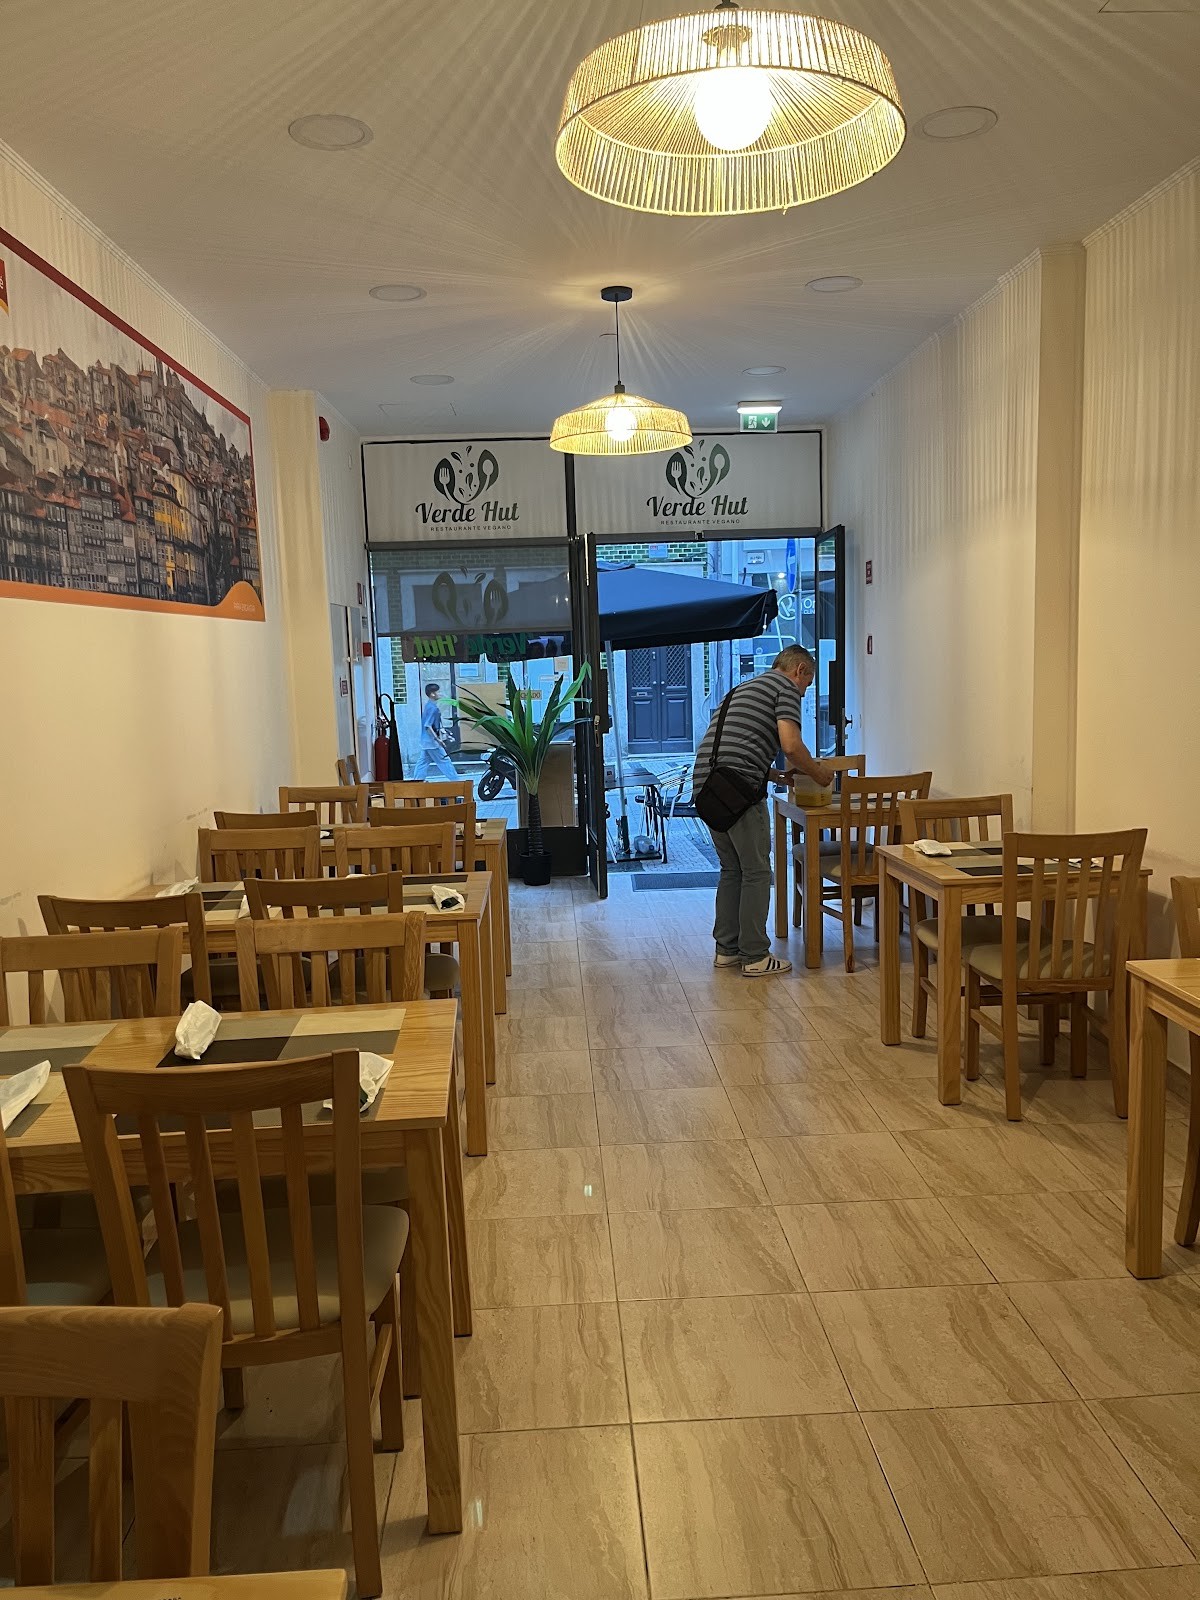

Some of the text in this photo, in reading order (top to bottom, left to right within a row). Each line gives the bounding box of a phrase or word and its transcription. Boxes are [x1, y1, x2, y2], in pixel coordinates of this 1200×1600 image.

[415, 500, 520, 524] Verde Hut
[646, 494, 749, 517] Verde Hut
